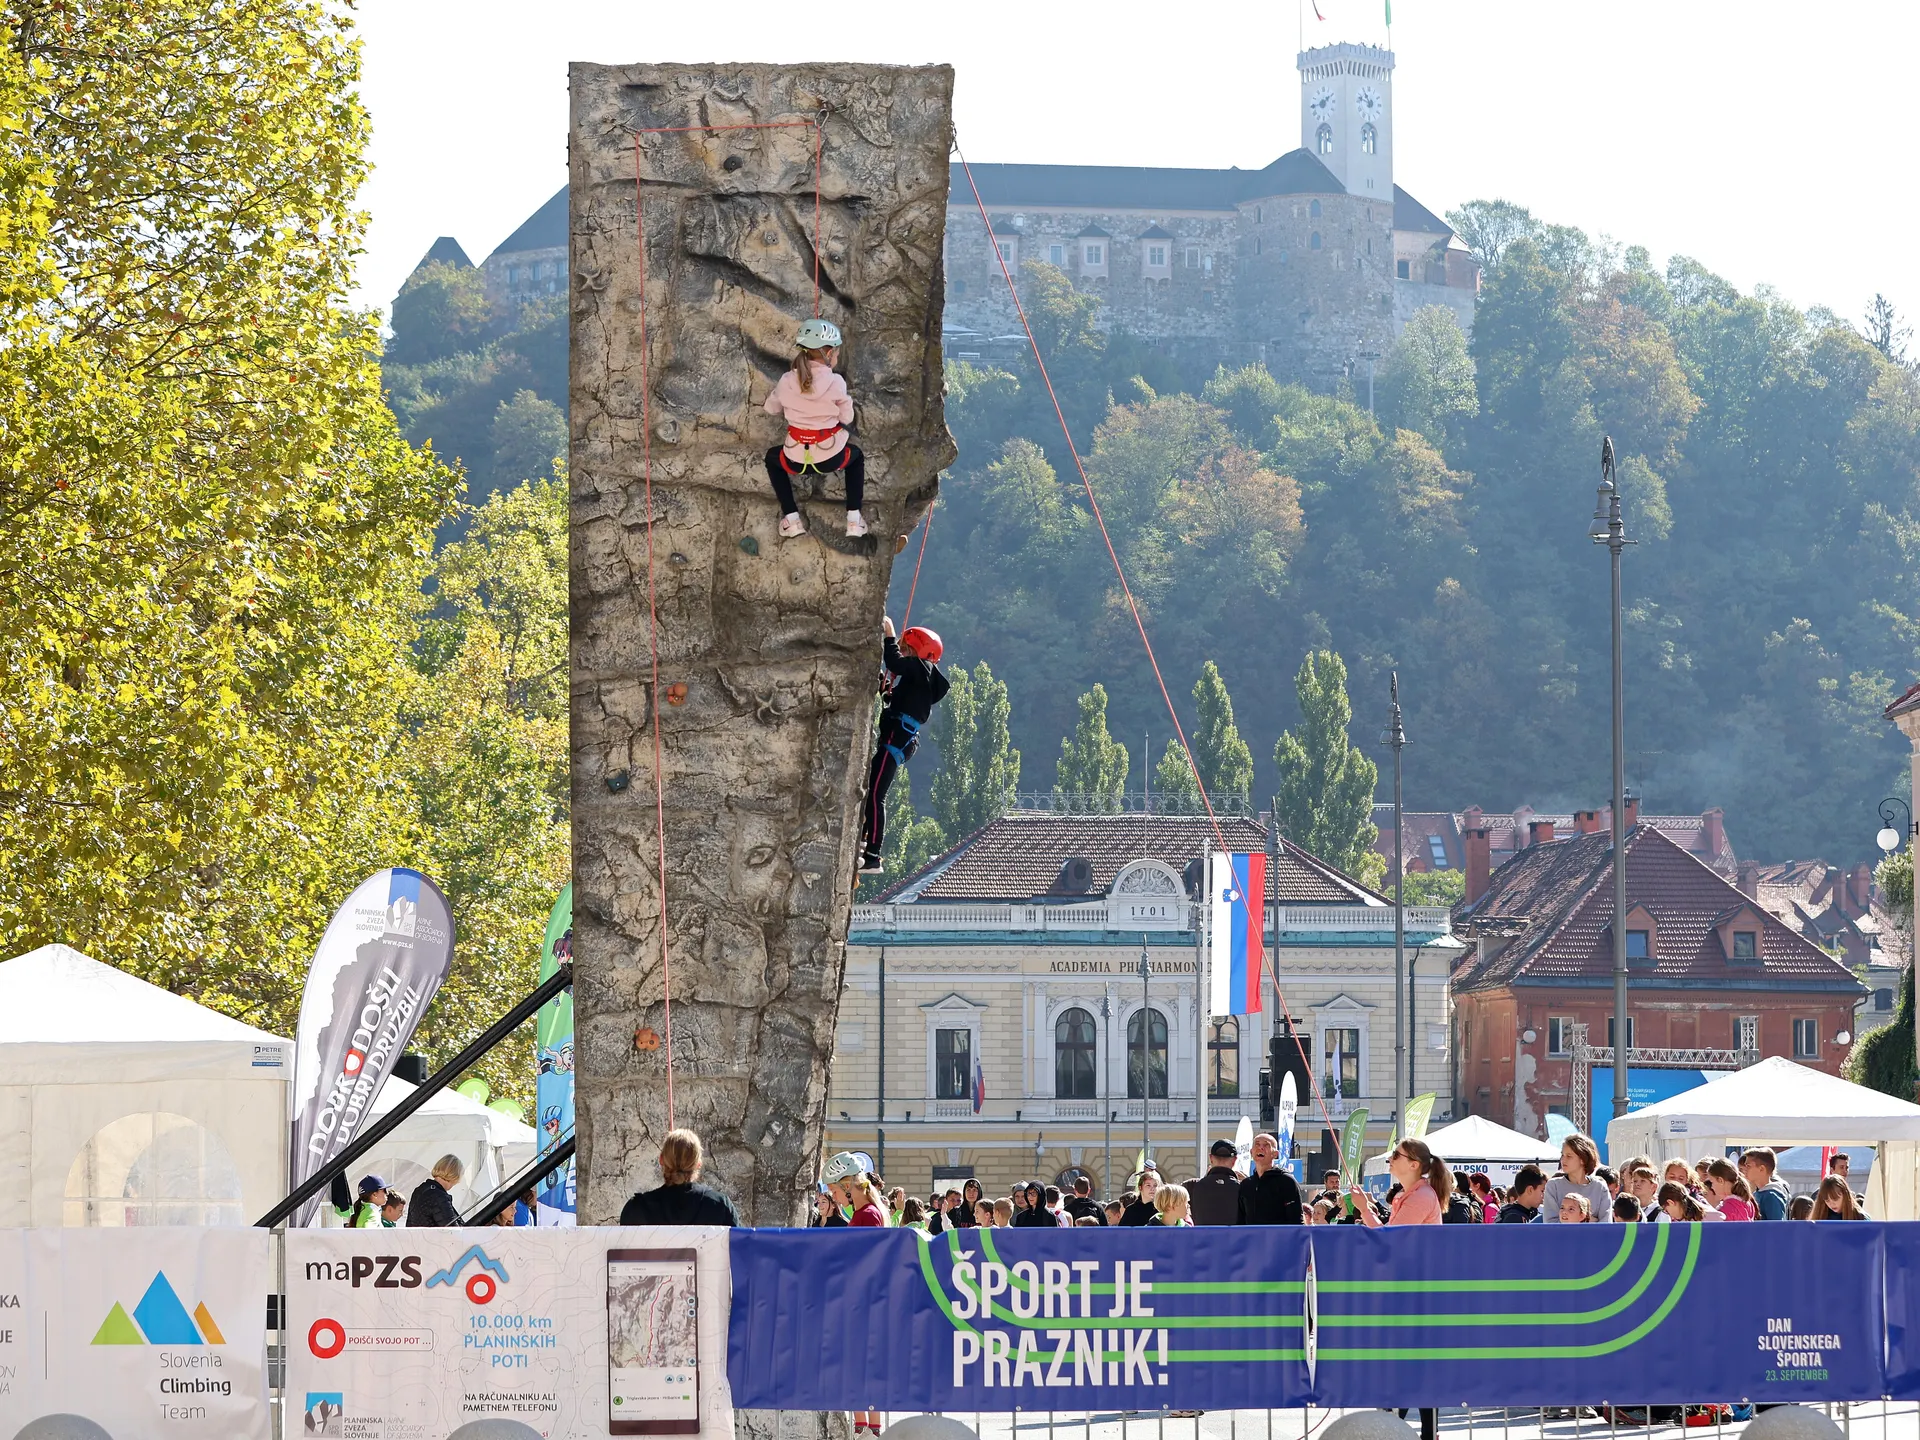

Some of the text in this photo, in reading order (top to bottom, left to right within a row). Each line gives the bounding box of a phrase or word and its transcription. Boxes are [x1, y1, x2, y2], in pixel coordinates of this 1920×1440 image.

[355, 908, 385, 917] PLANINSKA
[1130, 906, 1166, 916] 1701
[366, 917, 385, 925] ZVEZA
[355, 924, 384, 933] SLOVENIJE
[382, 939, 414, 949] www.pzs.si
[1050, 961, 1111, 972] ACADEMIA
[1348, 1131, 1360, 1161] FEEL
[1452, 1165, 1488, 1173] ALPSKO
[305, 1255, 422, 1288] maPZS
[951, 1250, 1155, 1319] ŠPORT JE
[469, 1315, 552, 1328] 10.000 km
[1767, 1318, 1792, 1333] DAN
[348, 1336, 374, 1345] POIŠČI
[375, 1337, 402, 1345] SVOJO
[403, 1337, 420, 1345] POT
[464, 1335, 556, 1348] PLANINSKIH
[1758, 1334, 1841, 1350] SLOVENSKEGA
[159, 1352, 222, 1368] Slovenia
[492, 1355, 528, 1367] POTI
[952, 1328, 1169, 1387] PRAZNIK!
[1776, 1349, 1823, 1367] ŠPORTA
[1765, 1369, 1828, 1381] 23. SEPTEMBER
[160, 1378, 232, 1396] Climbing
[478, 1391, 540, 1401] RAČUNALNIKU
[159, 1403, 206, 1419] Team
